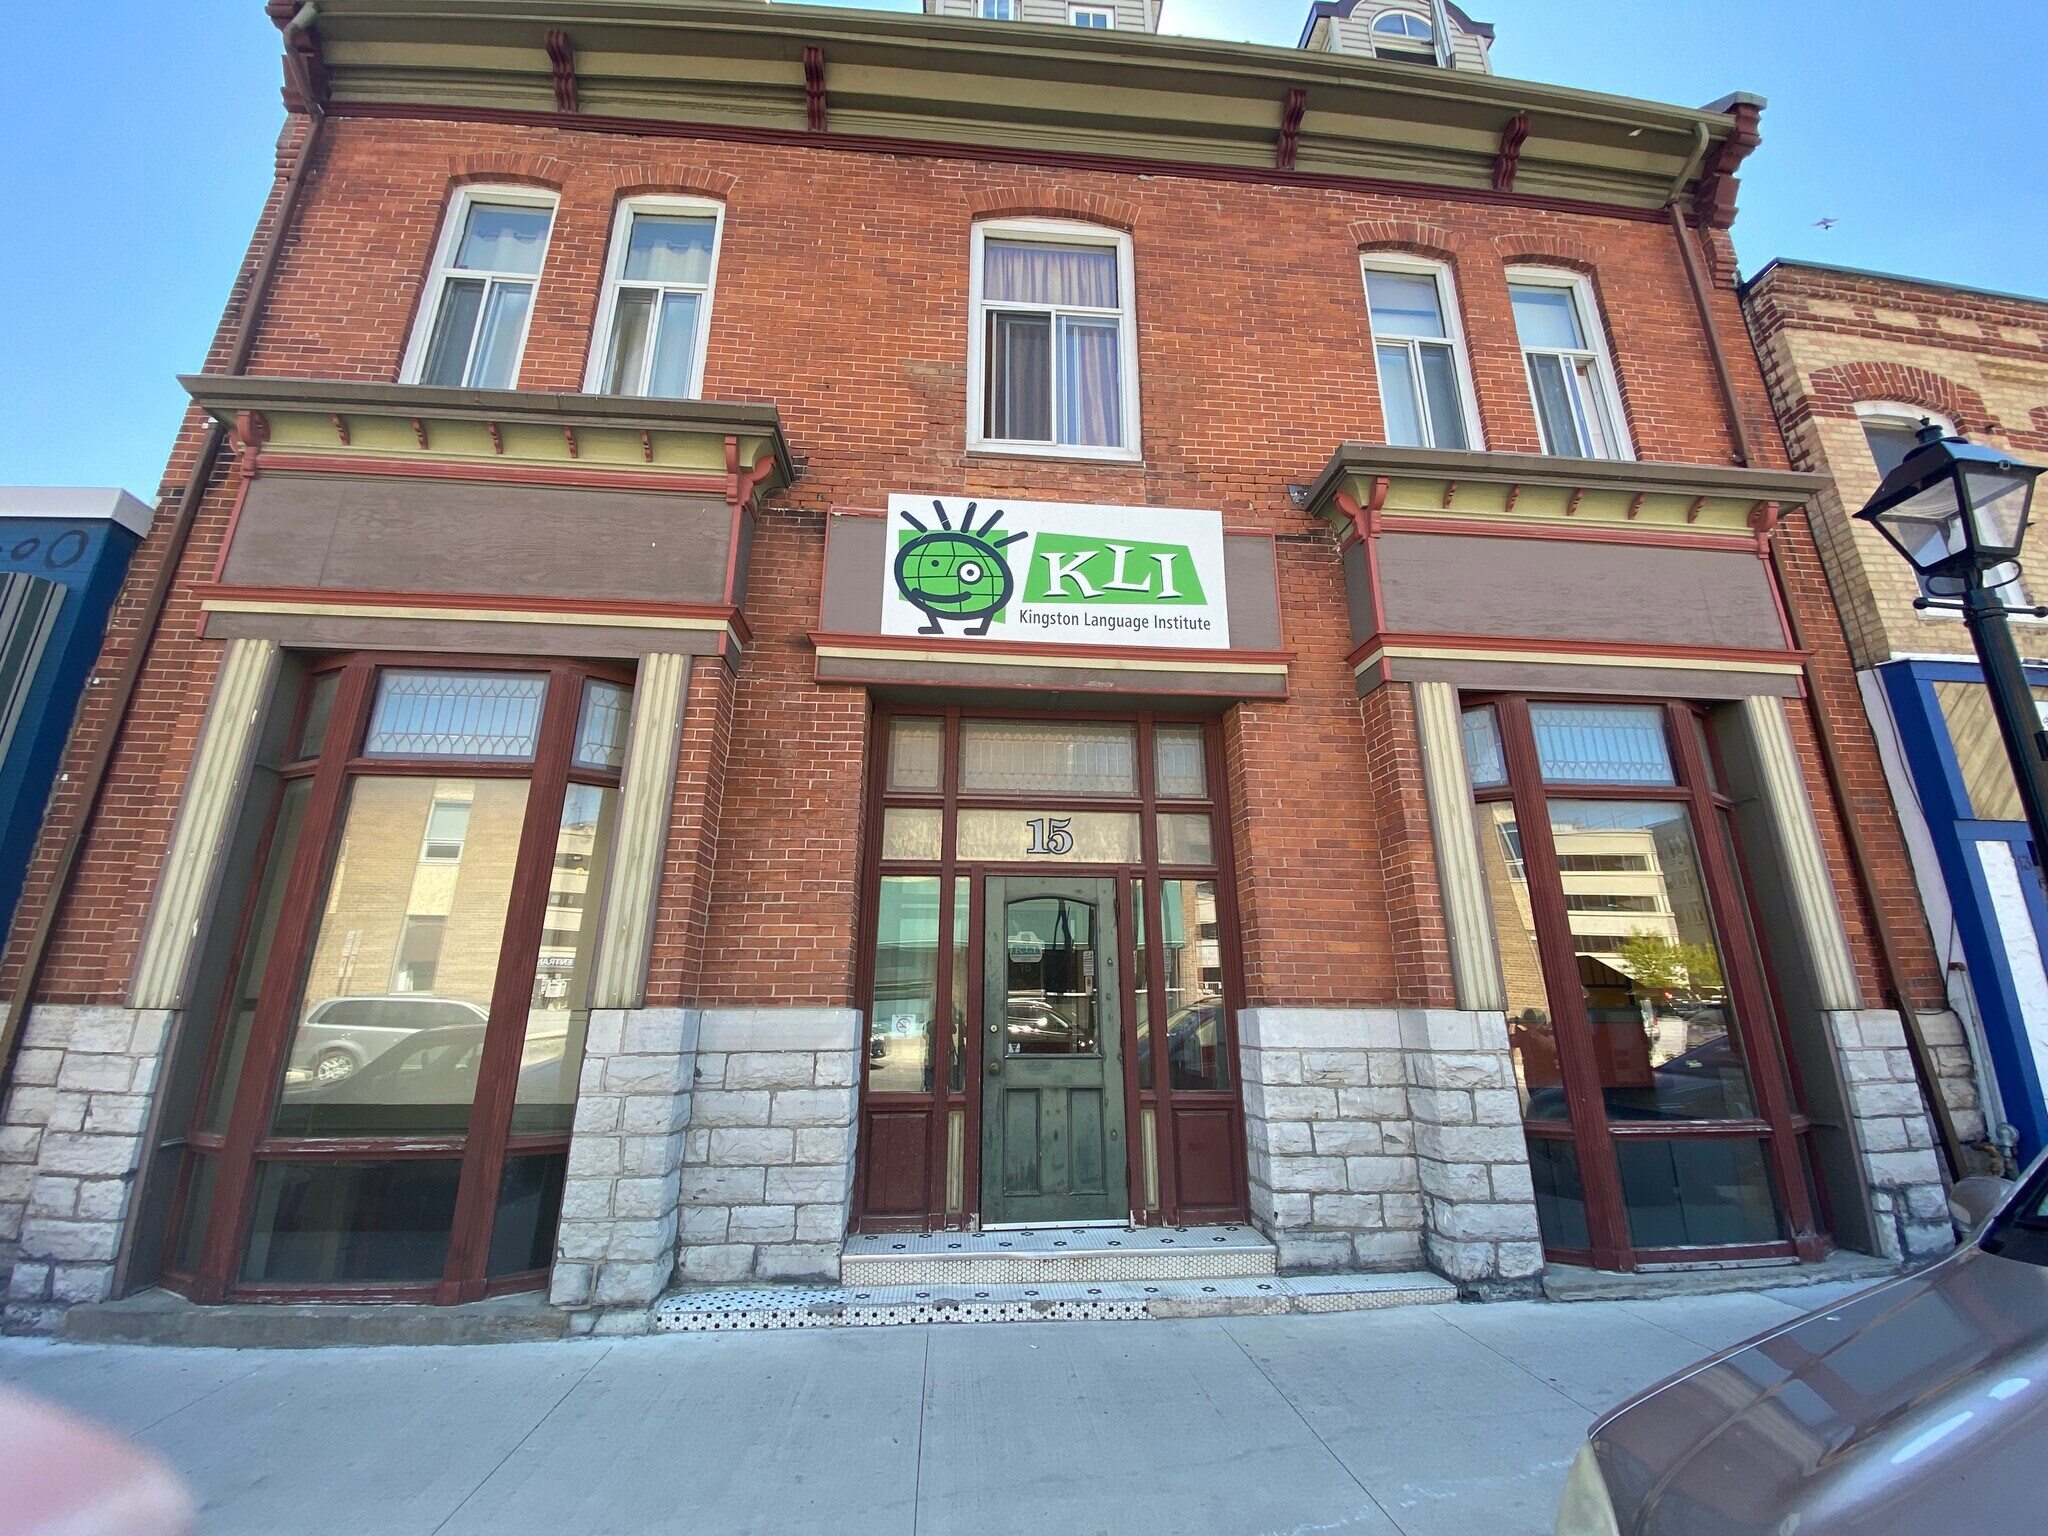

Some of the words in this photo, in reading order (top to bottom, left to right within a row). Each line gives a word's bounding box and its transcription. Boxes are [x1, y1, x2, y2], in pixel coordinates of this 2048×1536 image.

[1039, 543, 1184, 599] KLI
[1019, 609, 1079, 628] Kingston
[1084, 612, 1149, 632] Language
[1154, 614, 1211, 631] Institute
[1026, 817, 1074, 855] 15
